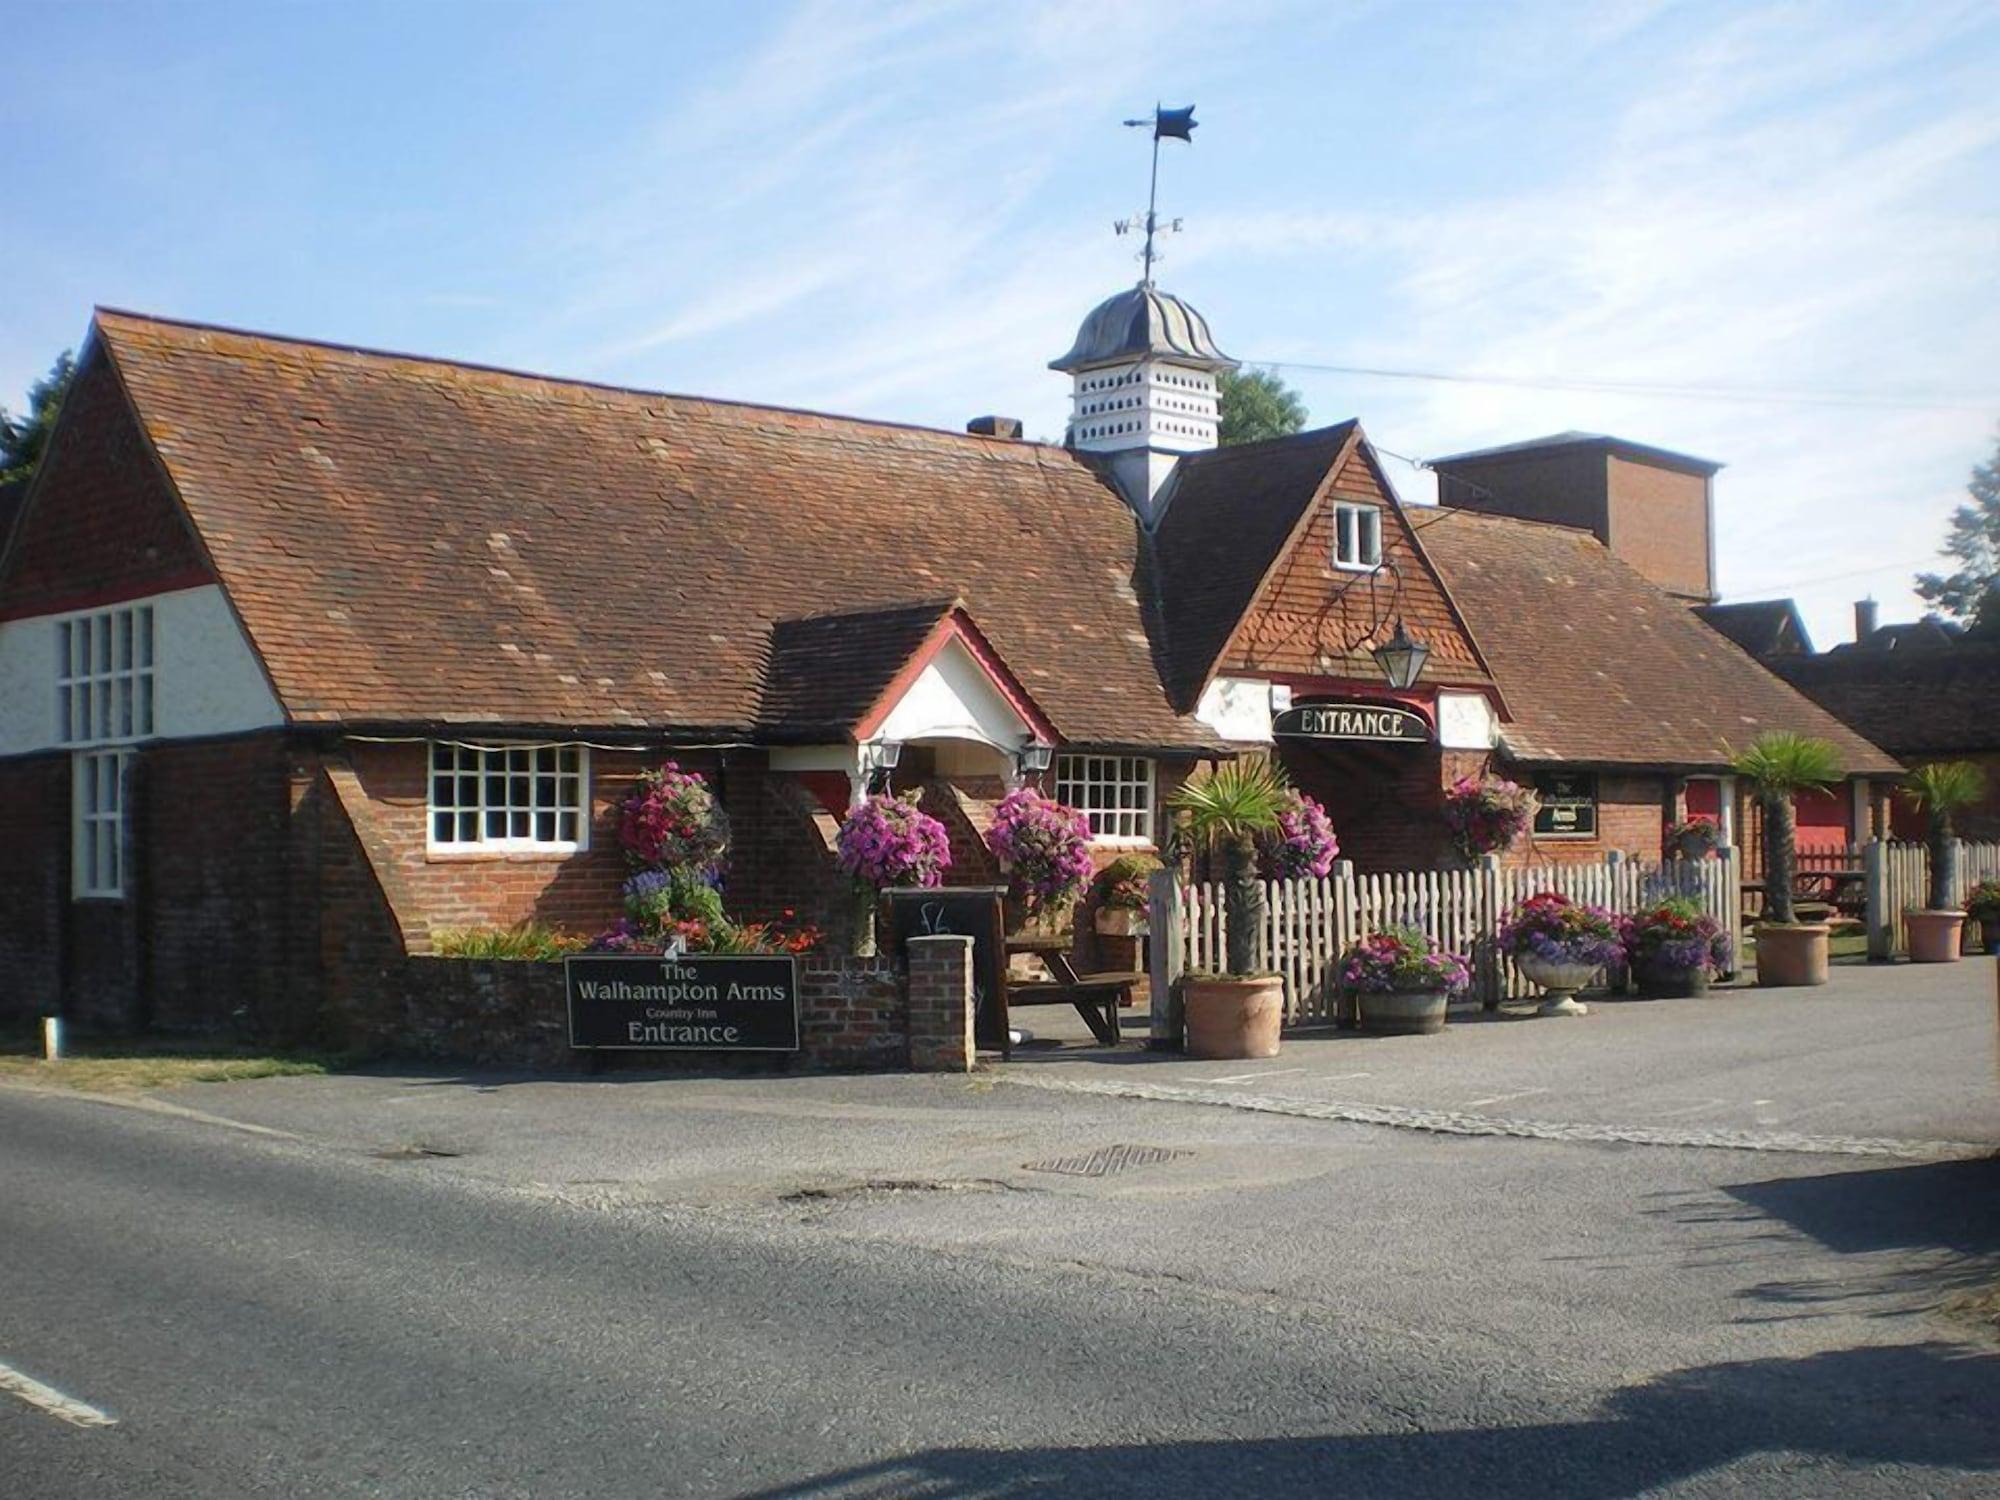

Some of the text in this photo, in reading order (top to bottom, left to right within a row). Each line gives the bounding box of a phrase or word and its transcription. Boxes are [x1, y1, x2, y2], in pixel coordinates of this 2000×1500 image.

[1114, 219, 1129, 235] W
[1172, 218, 1183, 232] E
[1302, 710, 1403, 735] ENTRANCE
[661, 964, 697, 980] The
[578, 981, 786, 1004] Walhampton Arms
[646, 1008, 718, 1021] Country Inn
[628, 1022, 739, 1042] Entrance
